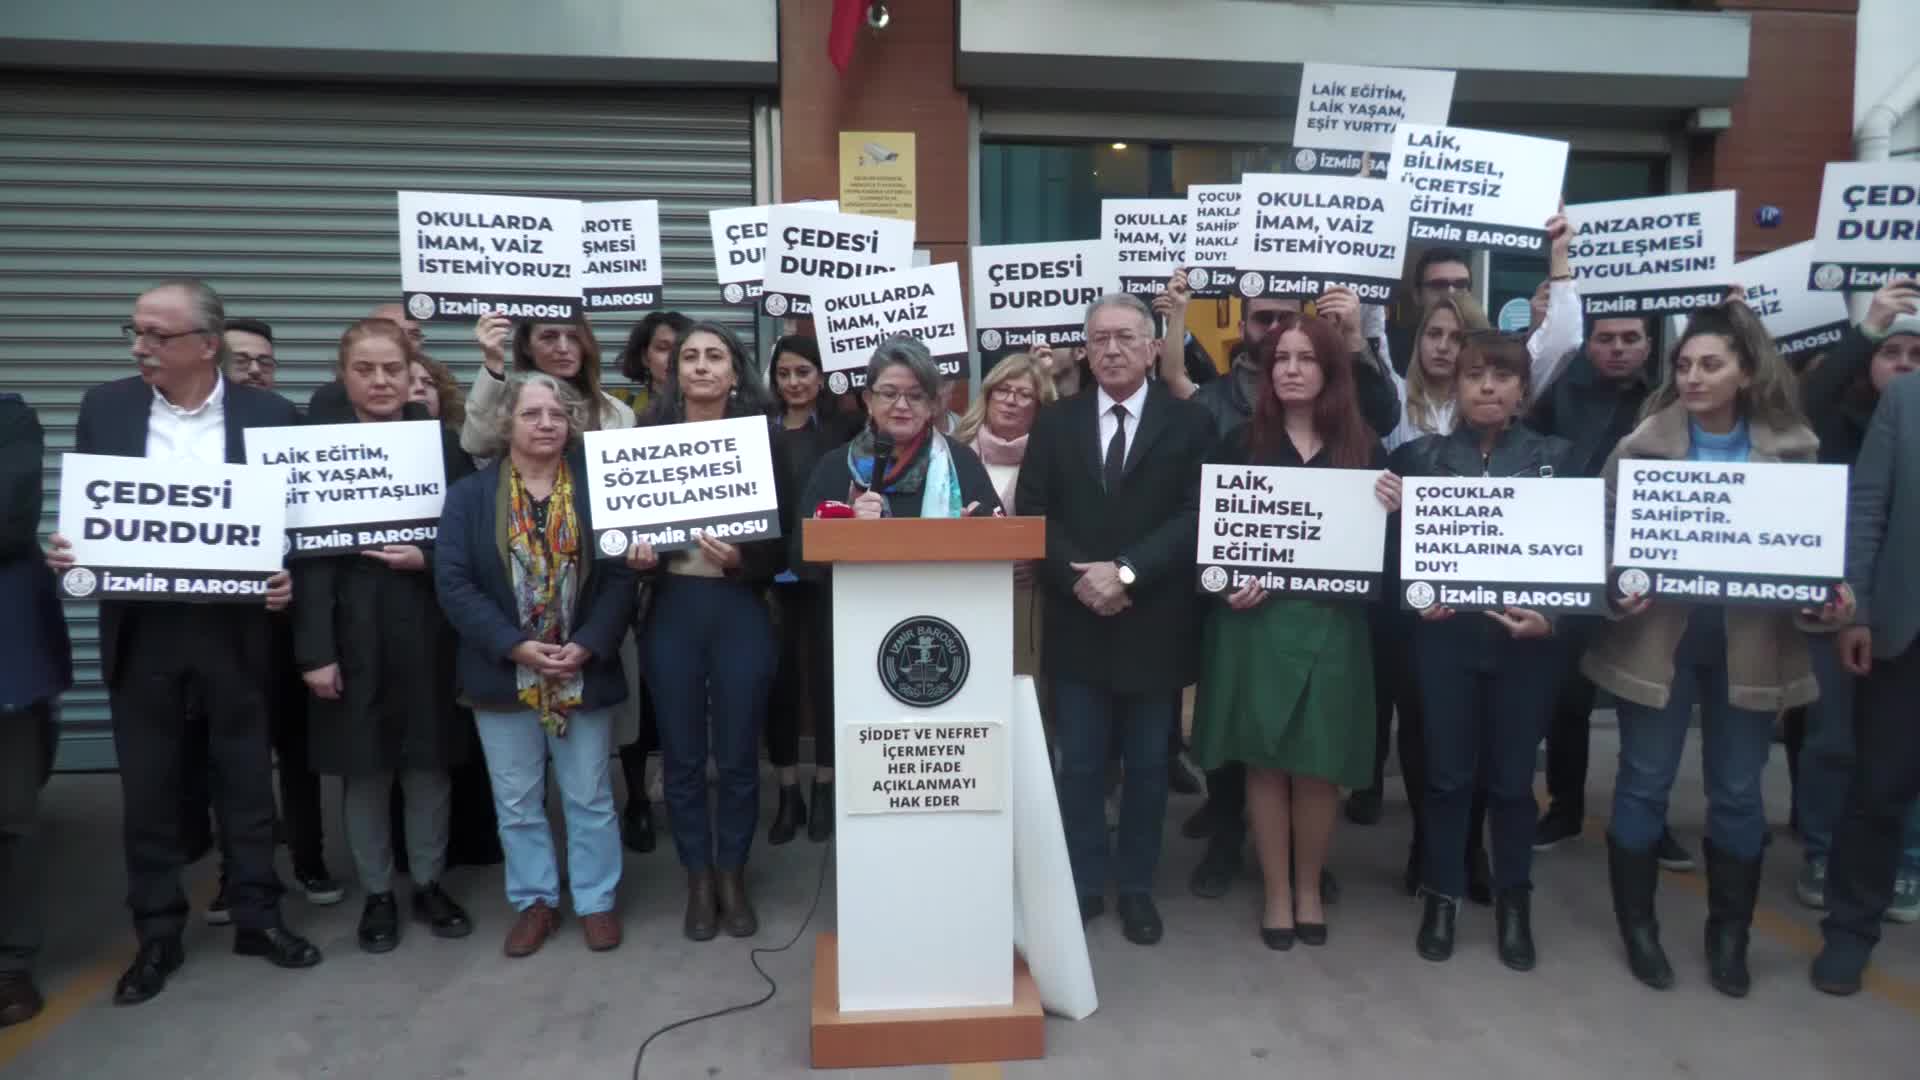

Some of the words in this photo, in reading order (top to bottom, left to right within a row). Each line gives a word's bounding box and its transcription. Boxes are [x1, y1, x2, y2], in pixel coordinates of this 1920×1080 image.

[1312, 83, 1346, 97] LAİK
[1350, 84, 1406, 102] EĞİTİM,
[1309, 99, 1343, 113] LAİK
[1349, 103, 1405, 120] YAŞAM,
[1307, 116, 1339, 132] EŞİT
[1407, 130, 1461, 151] LAİK,
[1404, 151, 1504, 179] BİLİMSEL,
[1257, 192, 1385, 212] OKULLARDA
[416, 211, 553, 232] OKULLARDA
[1196, 219, 1239, 232] SAHİP
[1256, 210, 1320, 233] İMAM,
[1327, 215, 1374, 234] VAİZ
[417, 230, 485, 254] İMAM,
[491, 235, 543, 254] VAİZ
[783, 227, 878, 254] ÇEDES'İ
[1411, 220, 1461, 241] İZMİR
[1466, 229, 1542, 250] BAROSU
[1567, 230, 1703, 258] SÖZLEŞMESİ
[1195, 251, 1227, 261] DUY!
[1254, 234, 1396, 259] İSTEMİYORUZ!
[418, 253, 571, 278] İSTEMİYORUZ!
[988, 254, 1083, 287] ÇEDES'İ
[1269, 275, 1319, 294] İZMİR
[440, 297, 490, 315] İZMİR
[495, 302, 572, 318] BAROSU
[591, 293, 653, 306] BAROSU
[825, 283, 935, 312] OKULLARDA
[1586, 296, 1637, 313] İZMİR
[1641, 293, 1722, 311] BAROSU
[827, 314, 880, 334] İMAM,
[884, 303, 929, 323] VAİZ
[1005, 330, 1047, 346] İZMİR
[1777, 329, 1842, 353] AROSU
[262, 447, 309, 465] LAİK
[316, 444, 388, 463] EĞİTİM,
[601, 437, 737, 464] LANZAROTE
[317, 466, 393, 485] YAŞAM,
[603, 455, 742, 488] SÖZLEŞMESİ
[1216, 471, 1274, 493] LAİK,
[1633, 470, 1746, 486] ÇOCUKLAR
[85, 479, 232, 510] ÇEDES'İ
[315, 482, 439, 503] YURTTAŞLIK!
[606, 481, 757, 511] UYGULANSIN!
[1415, 486, 1515, 501] ÇOCUKLAR
[1632, 489, 1732, 504] HAKLARA
[1215, 494, 1323, 520] BİLİMSEL,
[1415, 505, 1504, 518] HAKLARA
[1631, 505, 1732, 524] SAHİPTİR.
[83, 517, 261, 547] DURDUR!
[296, 530, 353, 550] İZMİR
[358, 526, 438, 546] BAROSU
[1214, 518, 1321, 541] ÜCRETSİZ
[1415, 520, 1504, 536] SAHİPTİR.
[1630, 527, 1752, 545] HAKLARINA
[1758, 532, 1821, 548] SAYGI
[1212, 542, 1295, 563] EĞİTİM!
[1415, 542, 1523, 556] HAKLARINA
[1528, 544, 1583, 556] SAYGI
[1629, 547, 1678, 561] DUY!
[1415, 560, 1458, 573] DUY!
[103, 572, 168, 592] İZMİR
[174, 578, 268, 594] BAROSU
[1290, 576, 1370, 593] BAROSU
[1655, 573, 1720, 596] İZMİR
[1727, 581, 1827, 602] BAROSU
[1440, 585, 1497, 604] İZMİR
[1503, 591, 1590, 606] BAROSU
[859, 726, 910, 744] ŞİDDET
[914, 728, 931, 740] VE
[936, 727, 989, 739] NEFRET
[883, 744, 965, 760] İÇERMEYEN
[888, 763, 916, 774] HER
[920, 760, 961, 773] İFADE
[872, 778, 976, 794] AÇIKLANMAYI
[889, 796, 920, 808] HAK
[925, 796, 959, 807] EDER
